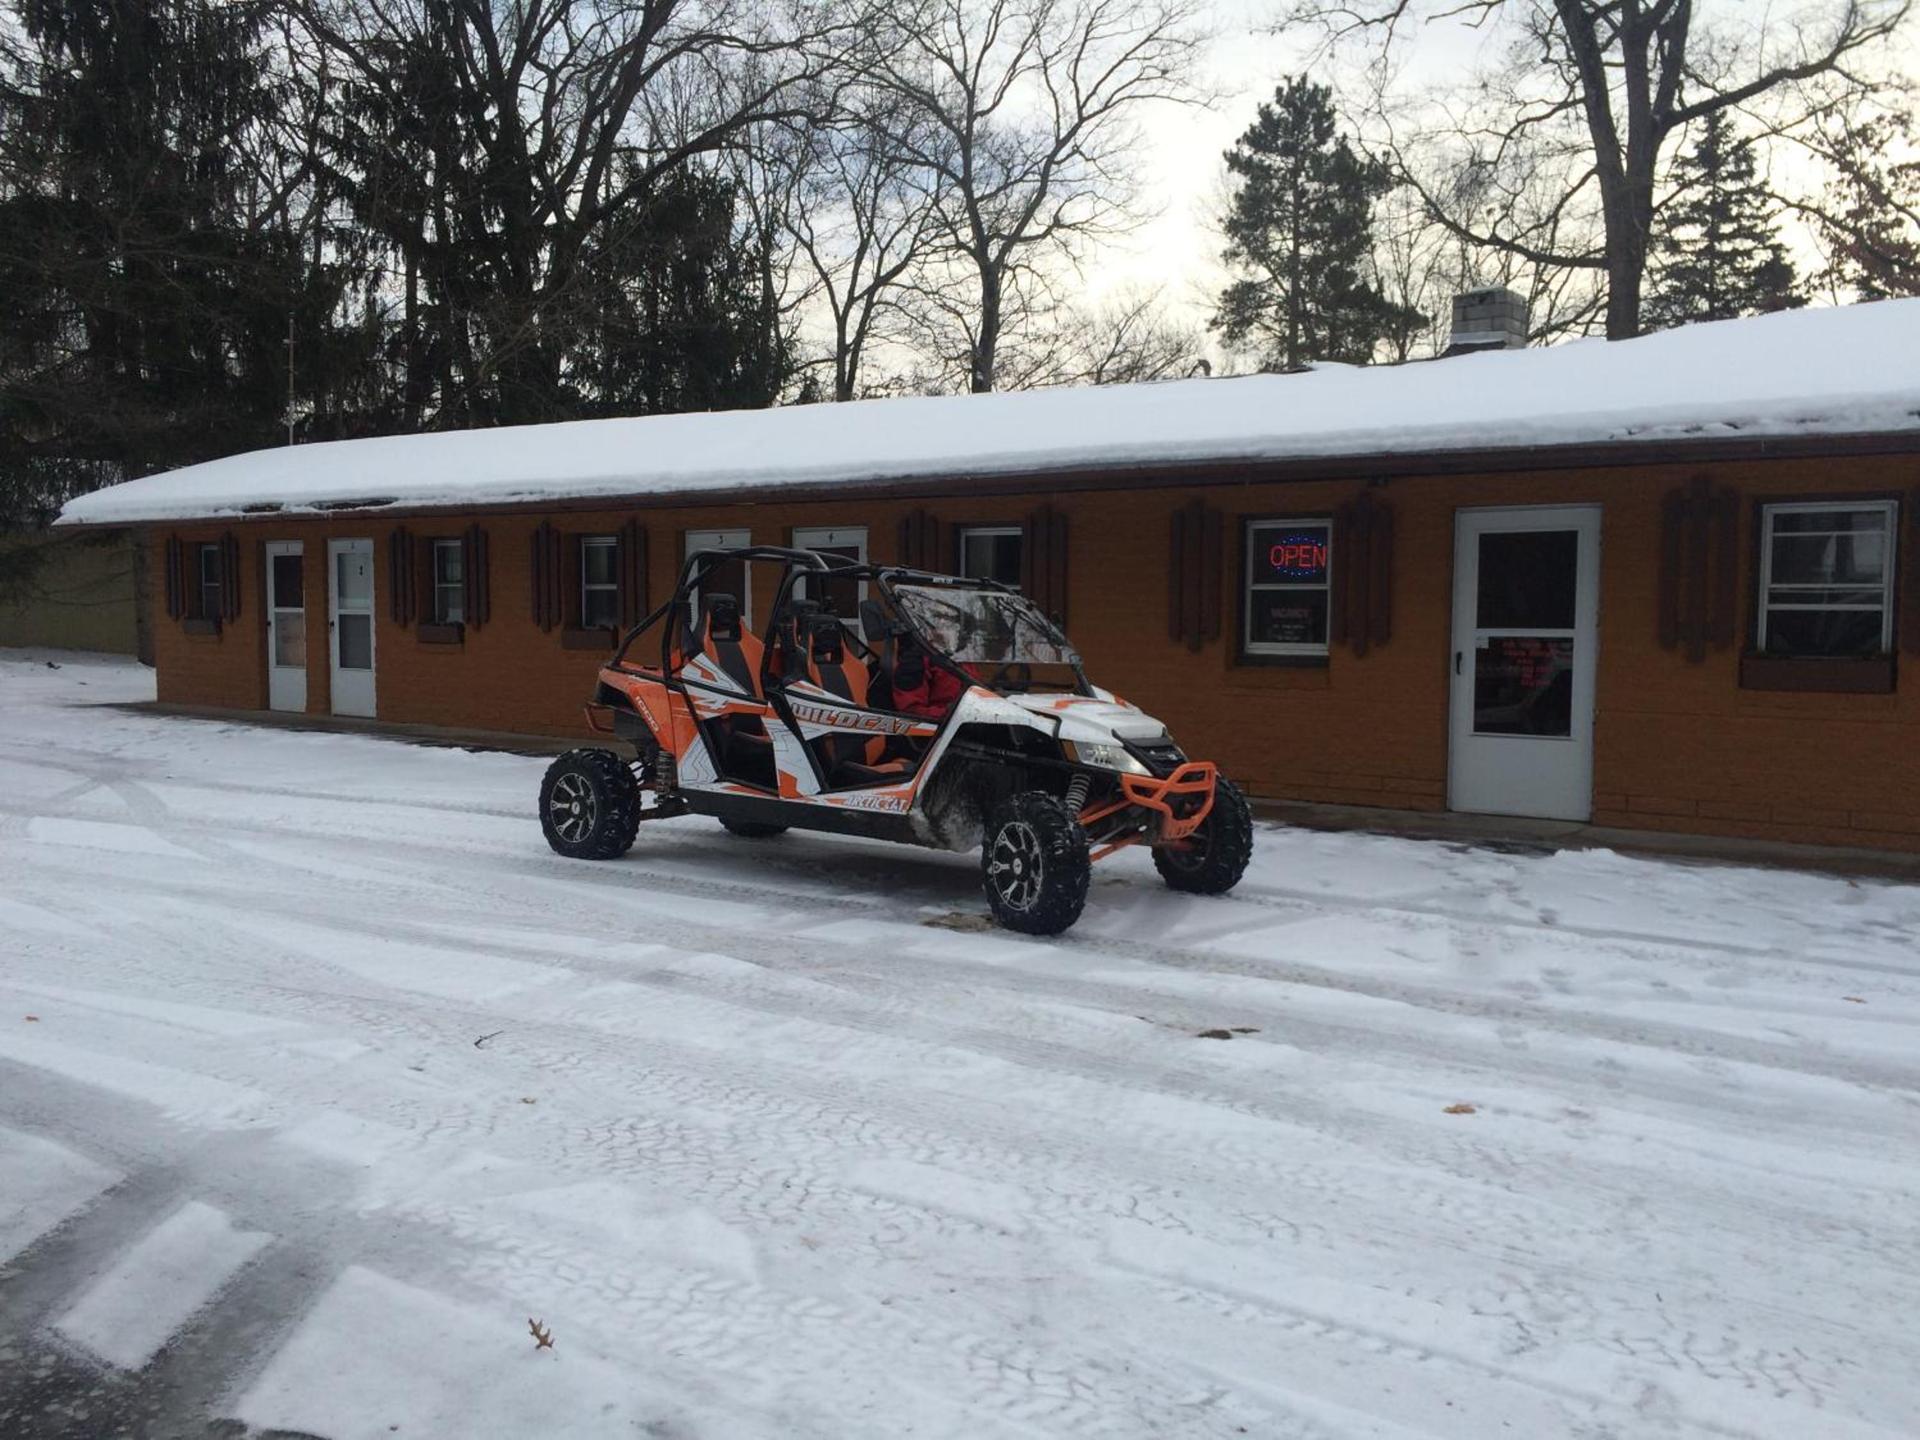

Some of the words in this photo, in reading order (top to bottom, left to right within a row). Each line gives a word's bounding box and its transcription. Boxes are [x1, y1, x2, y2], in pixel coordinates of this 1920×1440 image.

[1270, 544, 1327, 568] OPEN
[636, 695, 660, 732] 1000
[791, 703, 917, 735] WILDCAT
